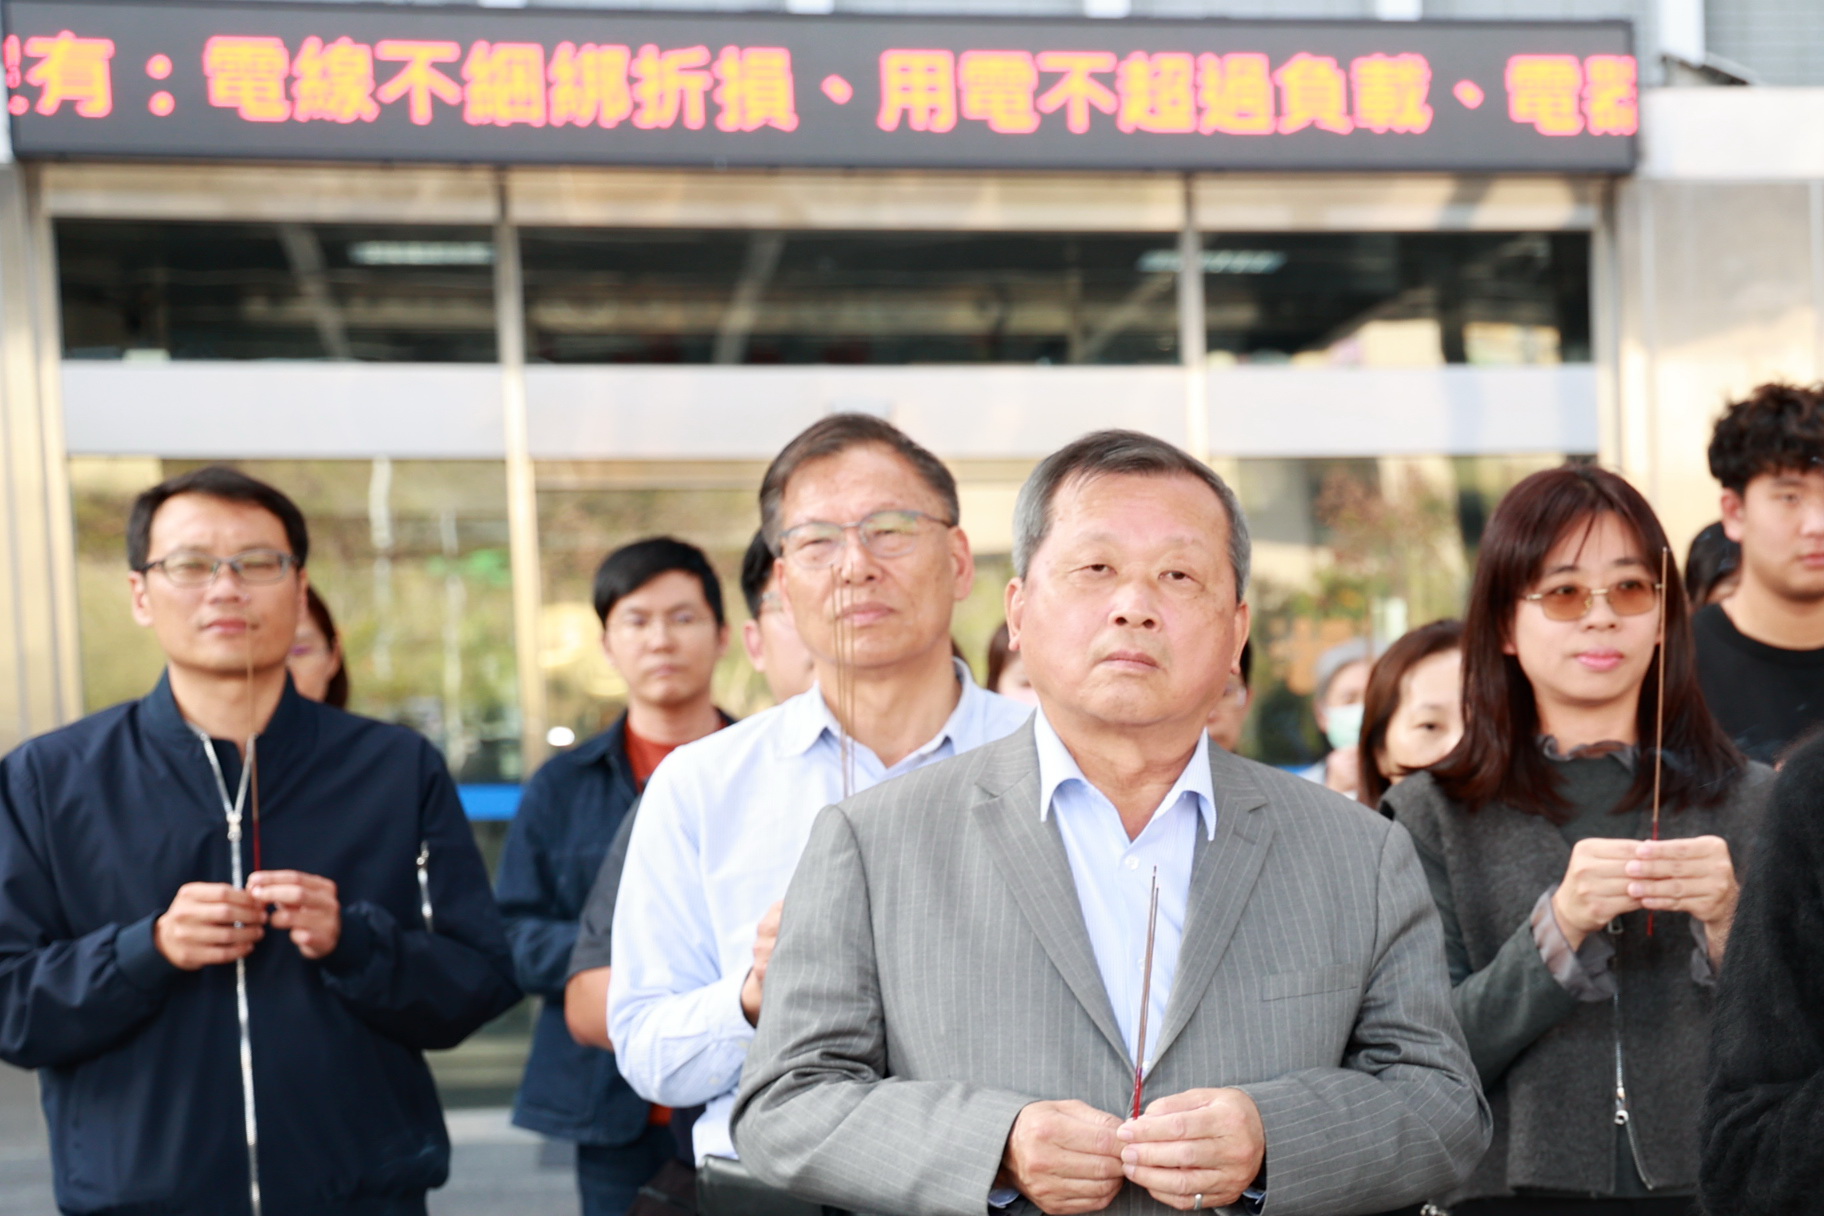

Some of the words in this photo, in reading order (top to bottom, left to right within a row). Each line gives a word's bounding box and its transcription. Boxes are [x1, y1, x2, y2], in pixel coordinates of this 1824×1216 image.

[4, 30, 1639, 136] 有：電線不綑綁折損、用電不超過負載、電器
